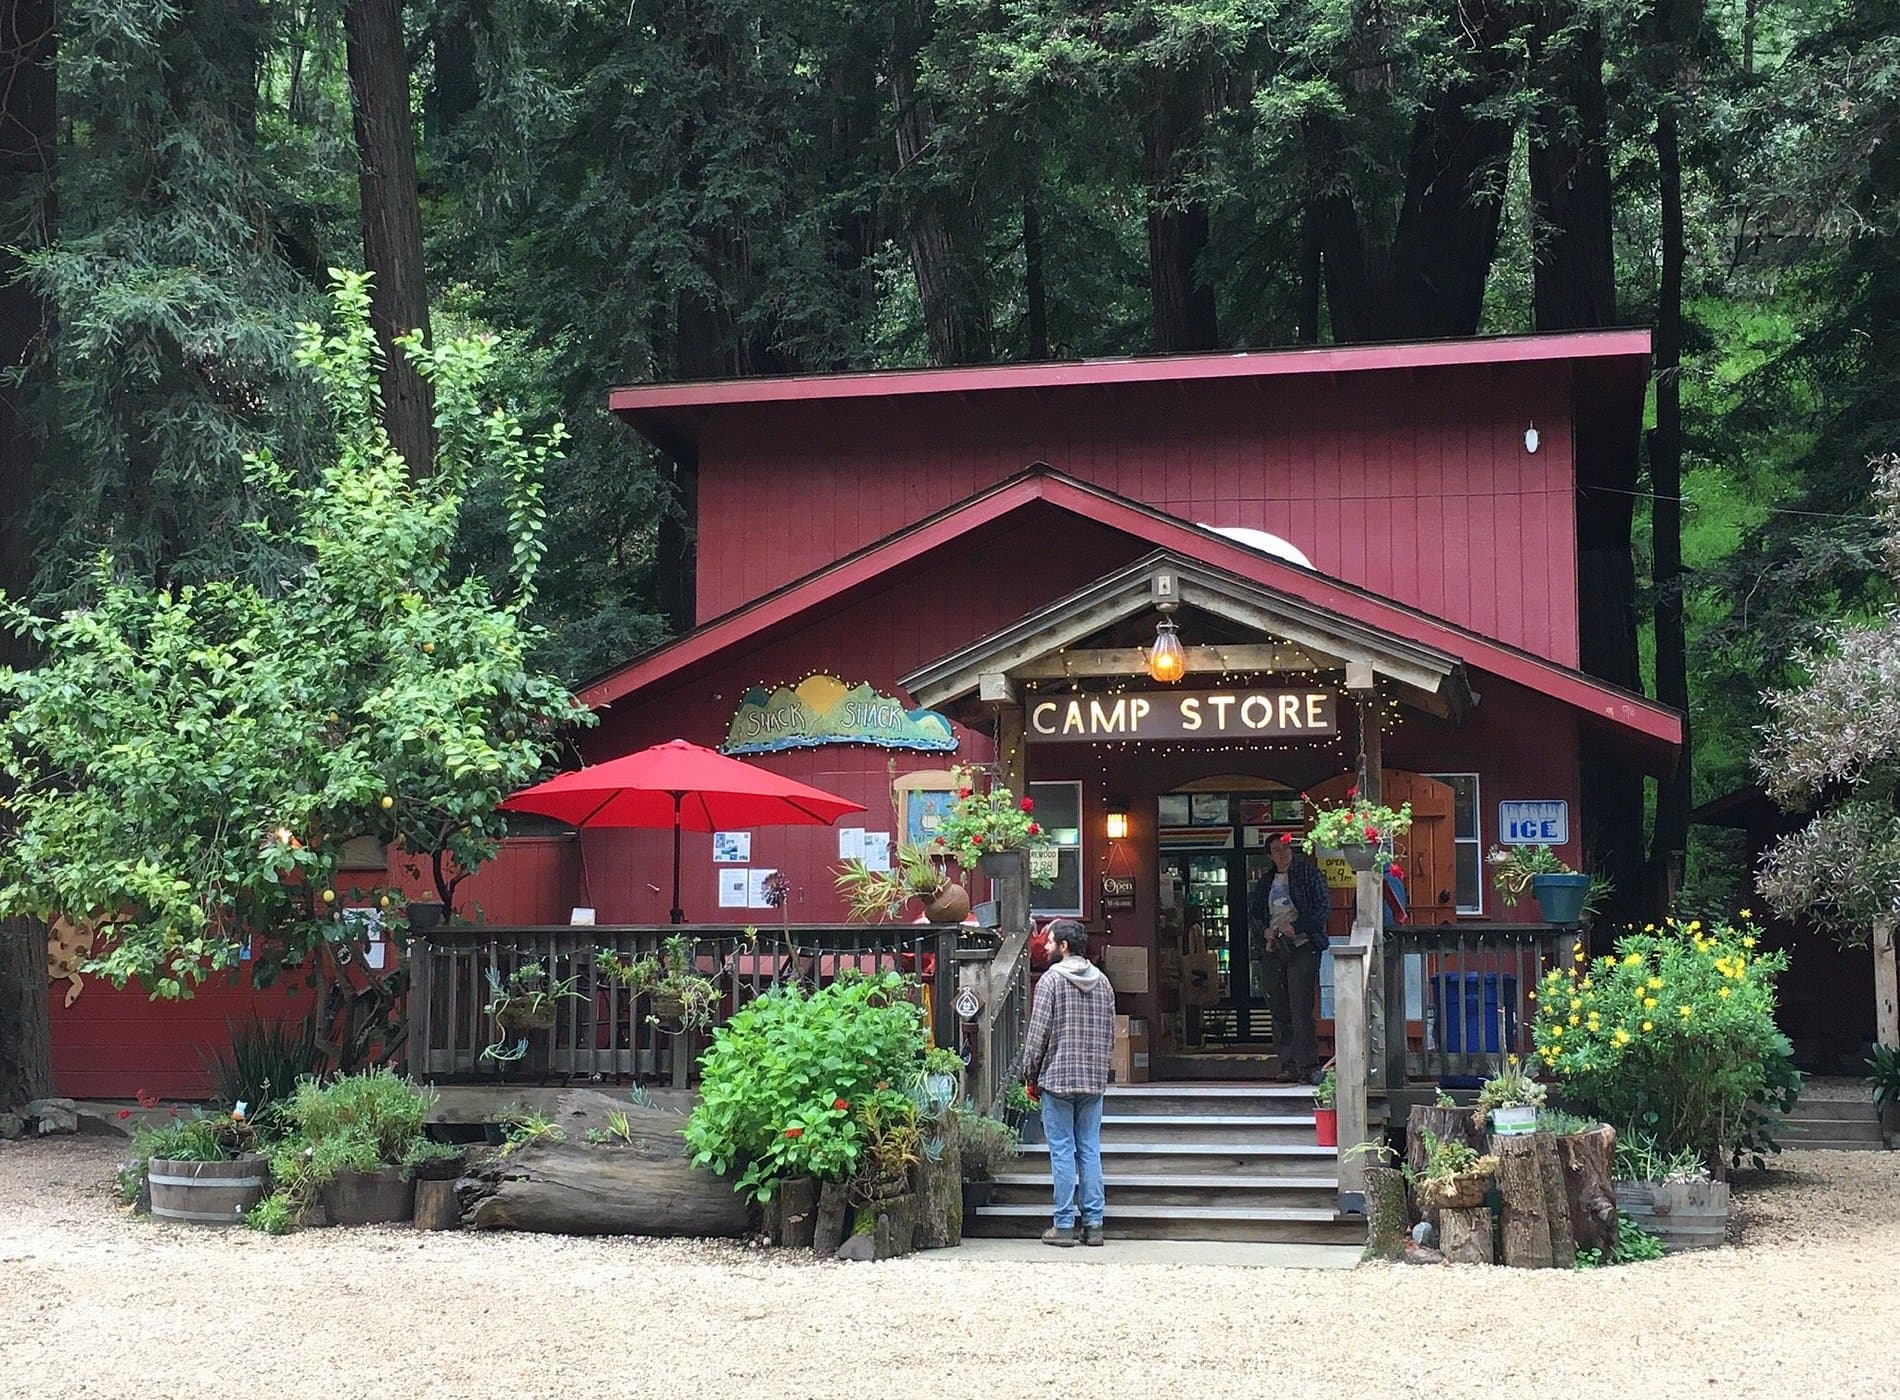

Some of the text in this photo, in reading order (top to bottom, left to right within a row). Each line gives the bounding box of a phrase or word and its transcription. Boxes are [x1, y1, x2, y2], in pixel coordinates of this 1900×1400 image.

[747, 701, 903, 737] SNACK SHACK
[1032, 694, 1328, 735] CAMP STORE
[1510, 820, 1558, 838] ICE
[1325, 858, 1346, 866] OPEN
[1104, 878, 1133, 894] Open
